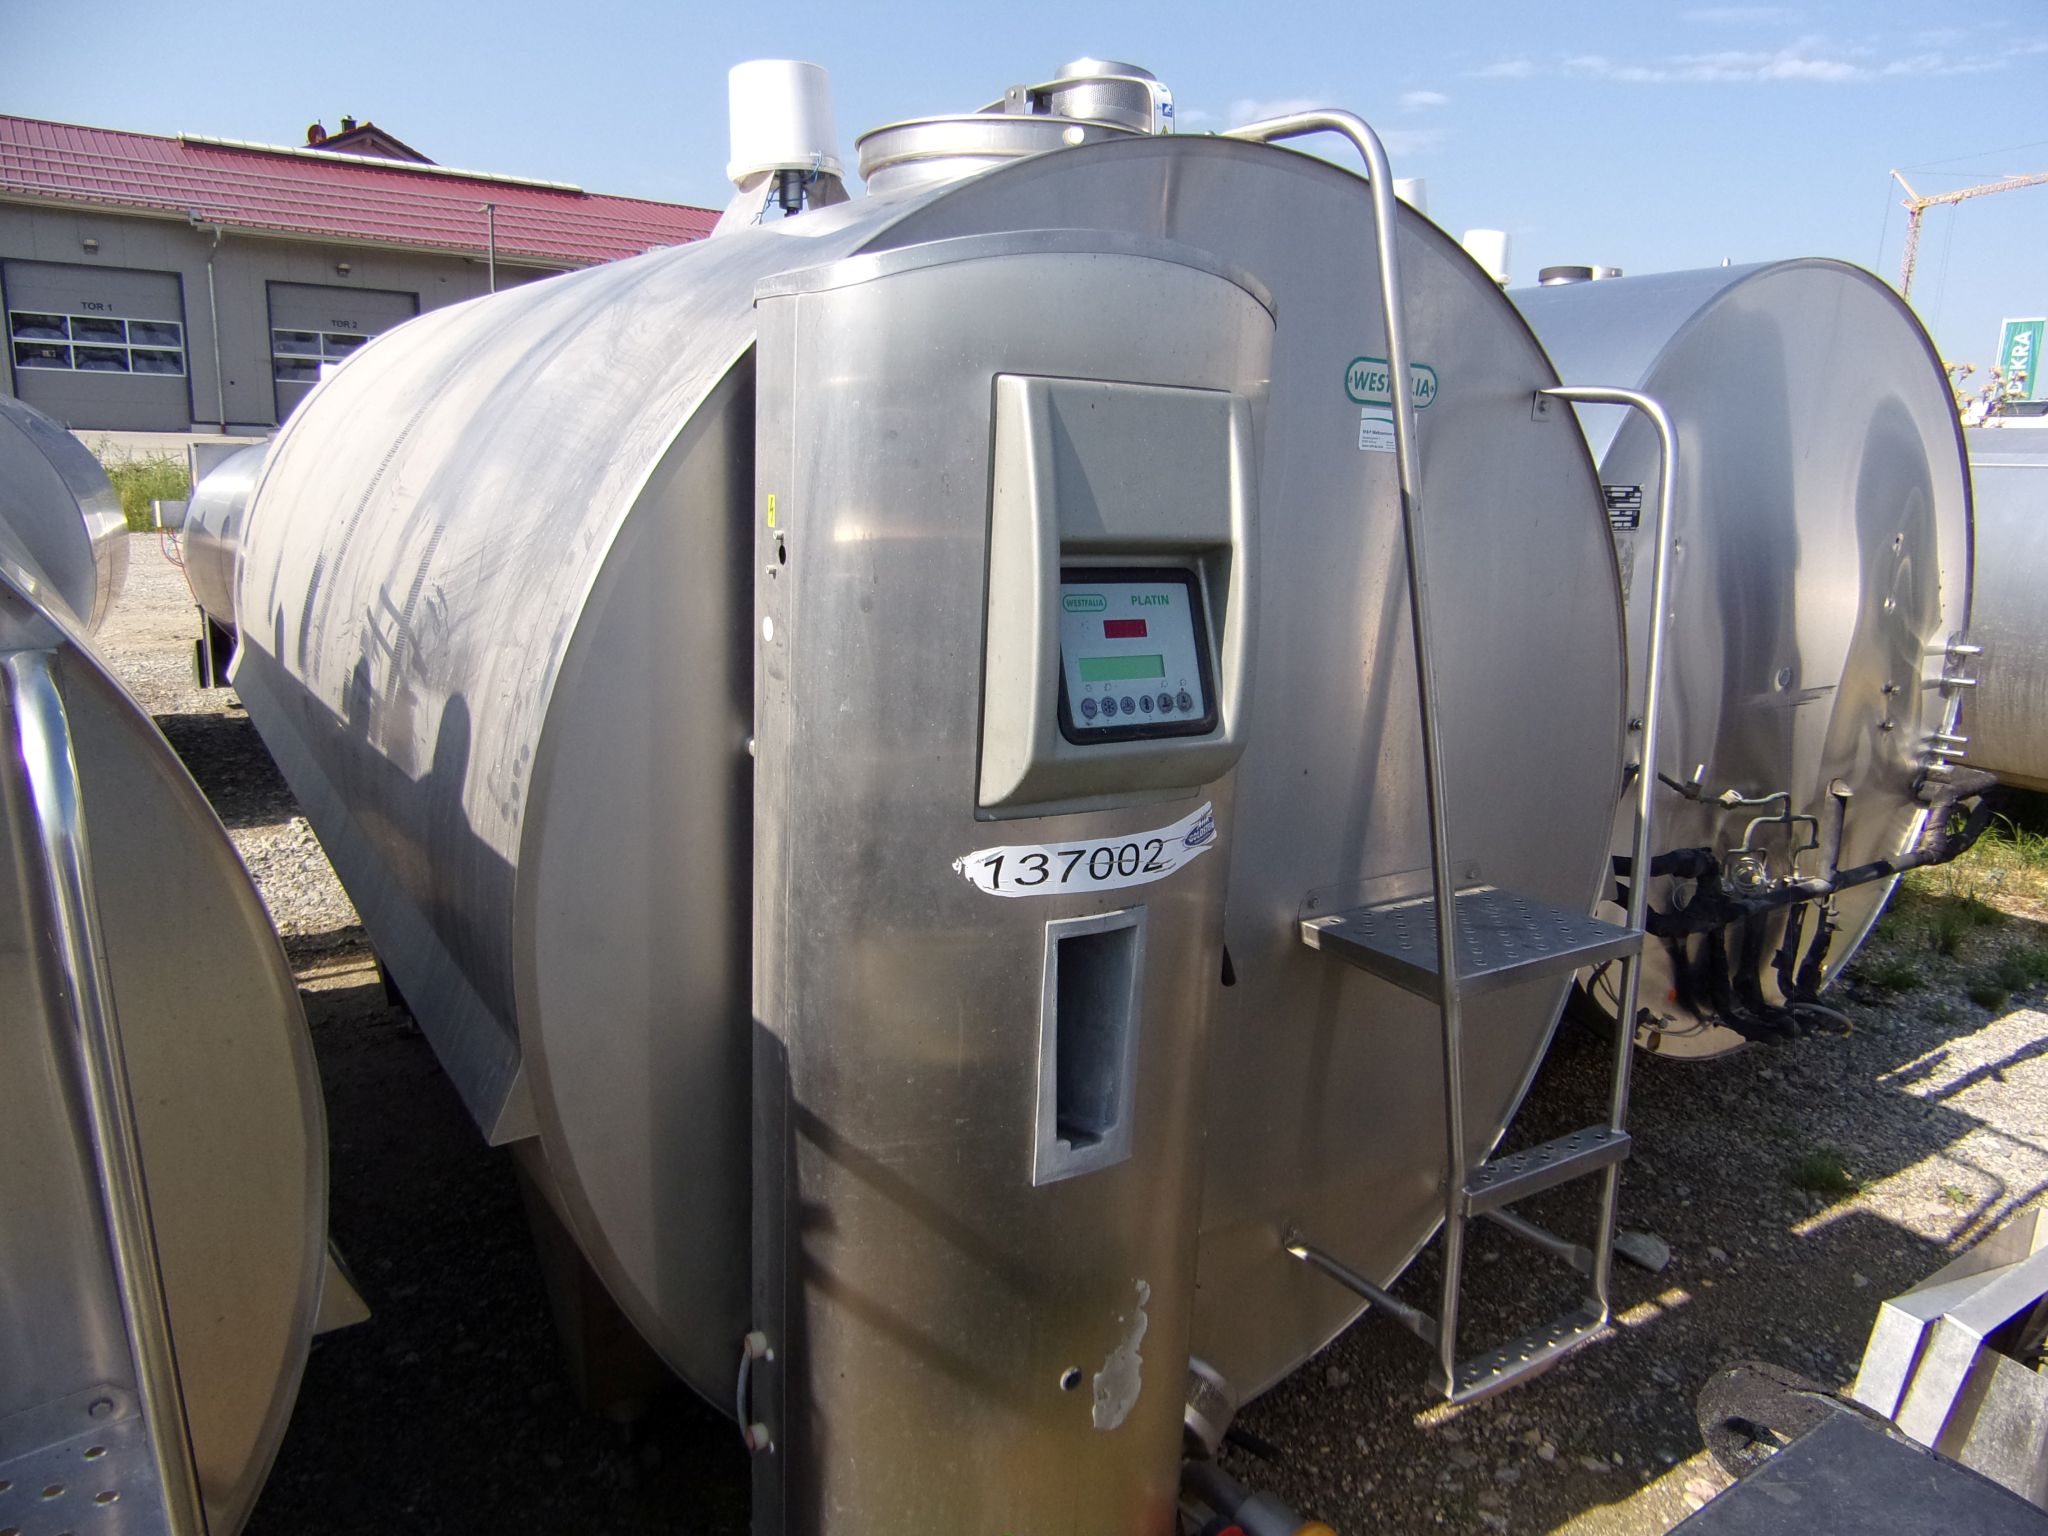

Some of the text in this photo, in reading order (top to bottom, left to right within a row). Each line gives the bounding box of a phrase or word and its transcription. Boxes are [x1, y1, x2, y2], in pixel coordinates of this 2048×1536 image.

[80, 301, 113, 312] TOR 1
[331, 319, 358, 329] TOR 2
[1066, 599, 1104, 608] WESTFALIA
[1131, 594, 1170, 606] PLATIN
[983, 838, 1164, 890] 137002
